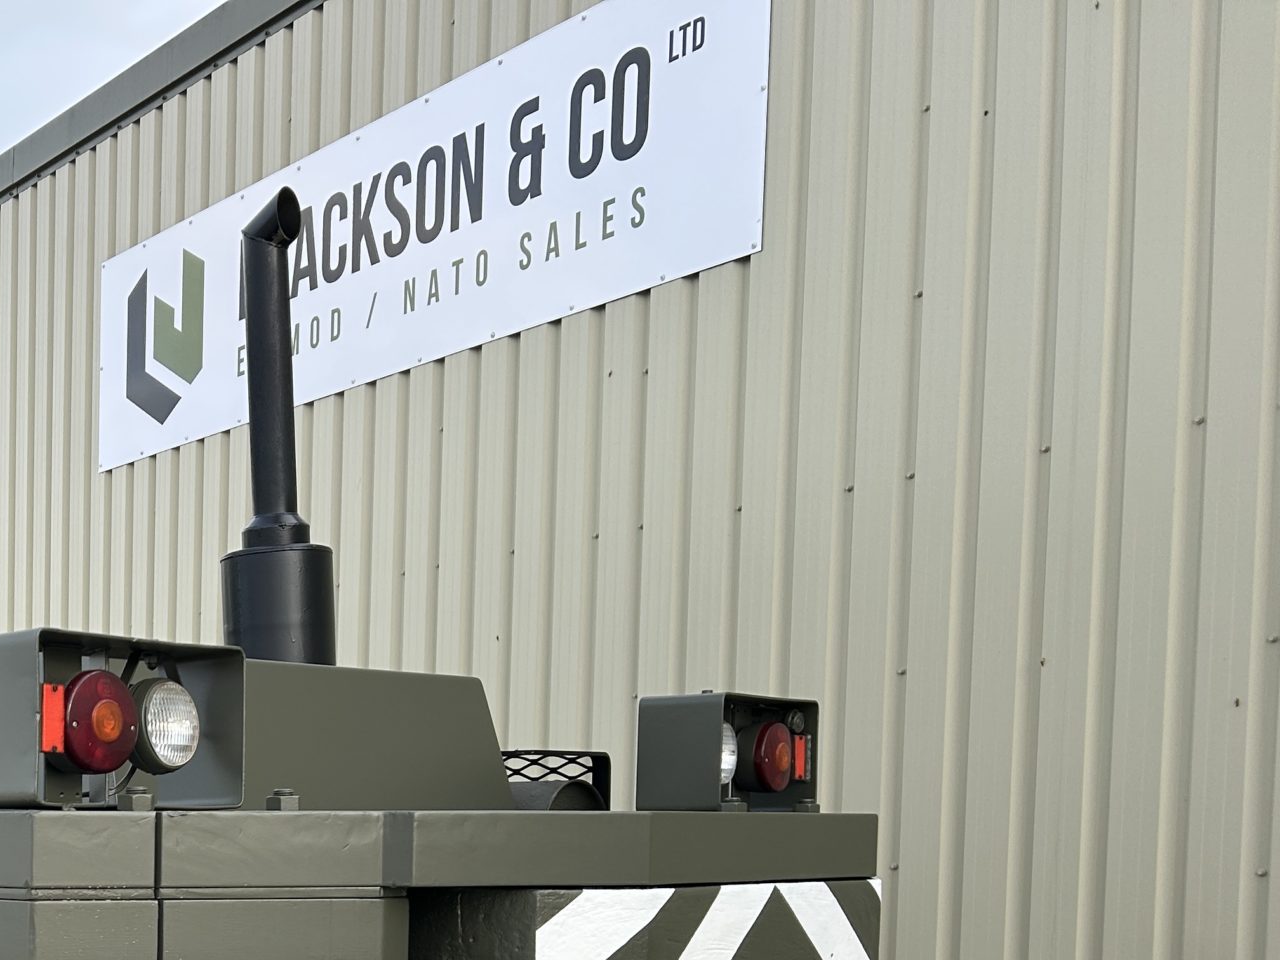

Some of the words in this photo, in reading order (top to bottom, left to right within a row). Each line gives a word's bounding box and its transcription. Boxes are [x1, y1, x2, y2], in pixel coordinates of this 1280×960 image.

[289, 122, 486, 300] ACKSON
[508, 95, 546, 207] &
[568, 46, 651, 180] CO
[668, 15, 706, 64] LTD
[365, 291, 378, 329] /
[403, 249, 488, 315] NATO
[519, 186, 646, 271] SALES
